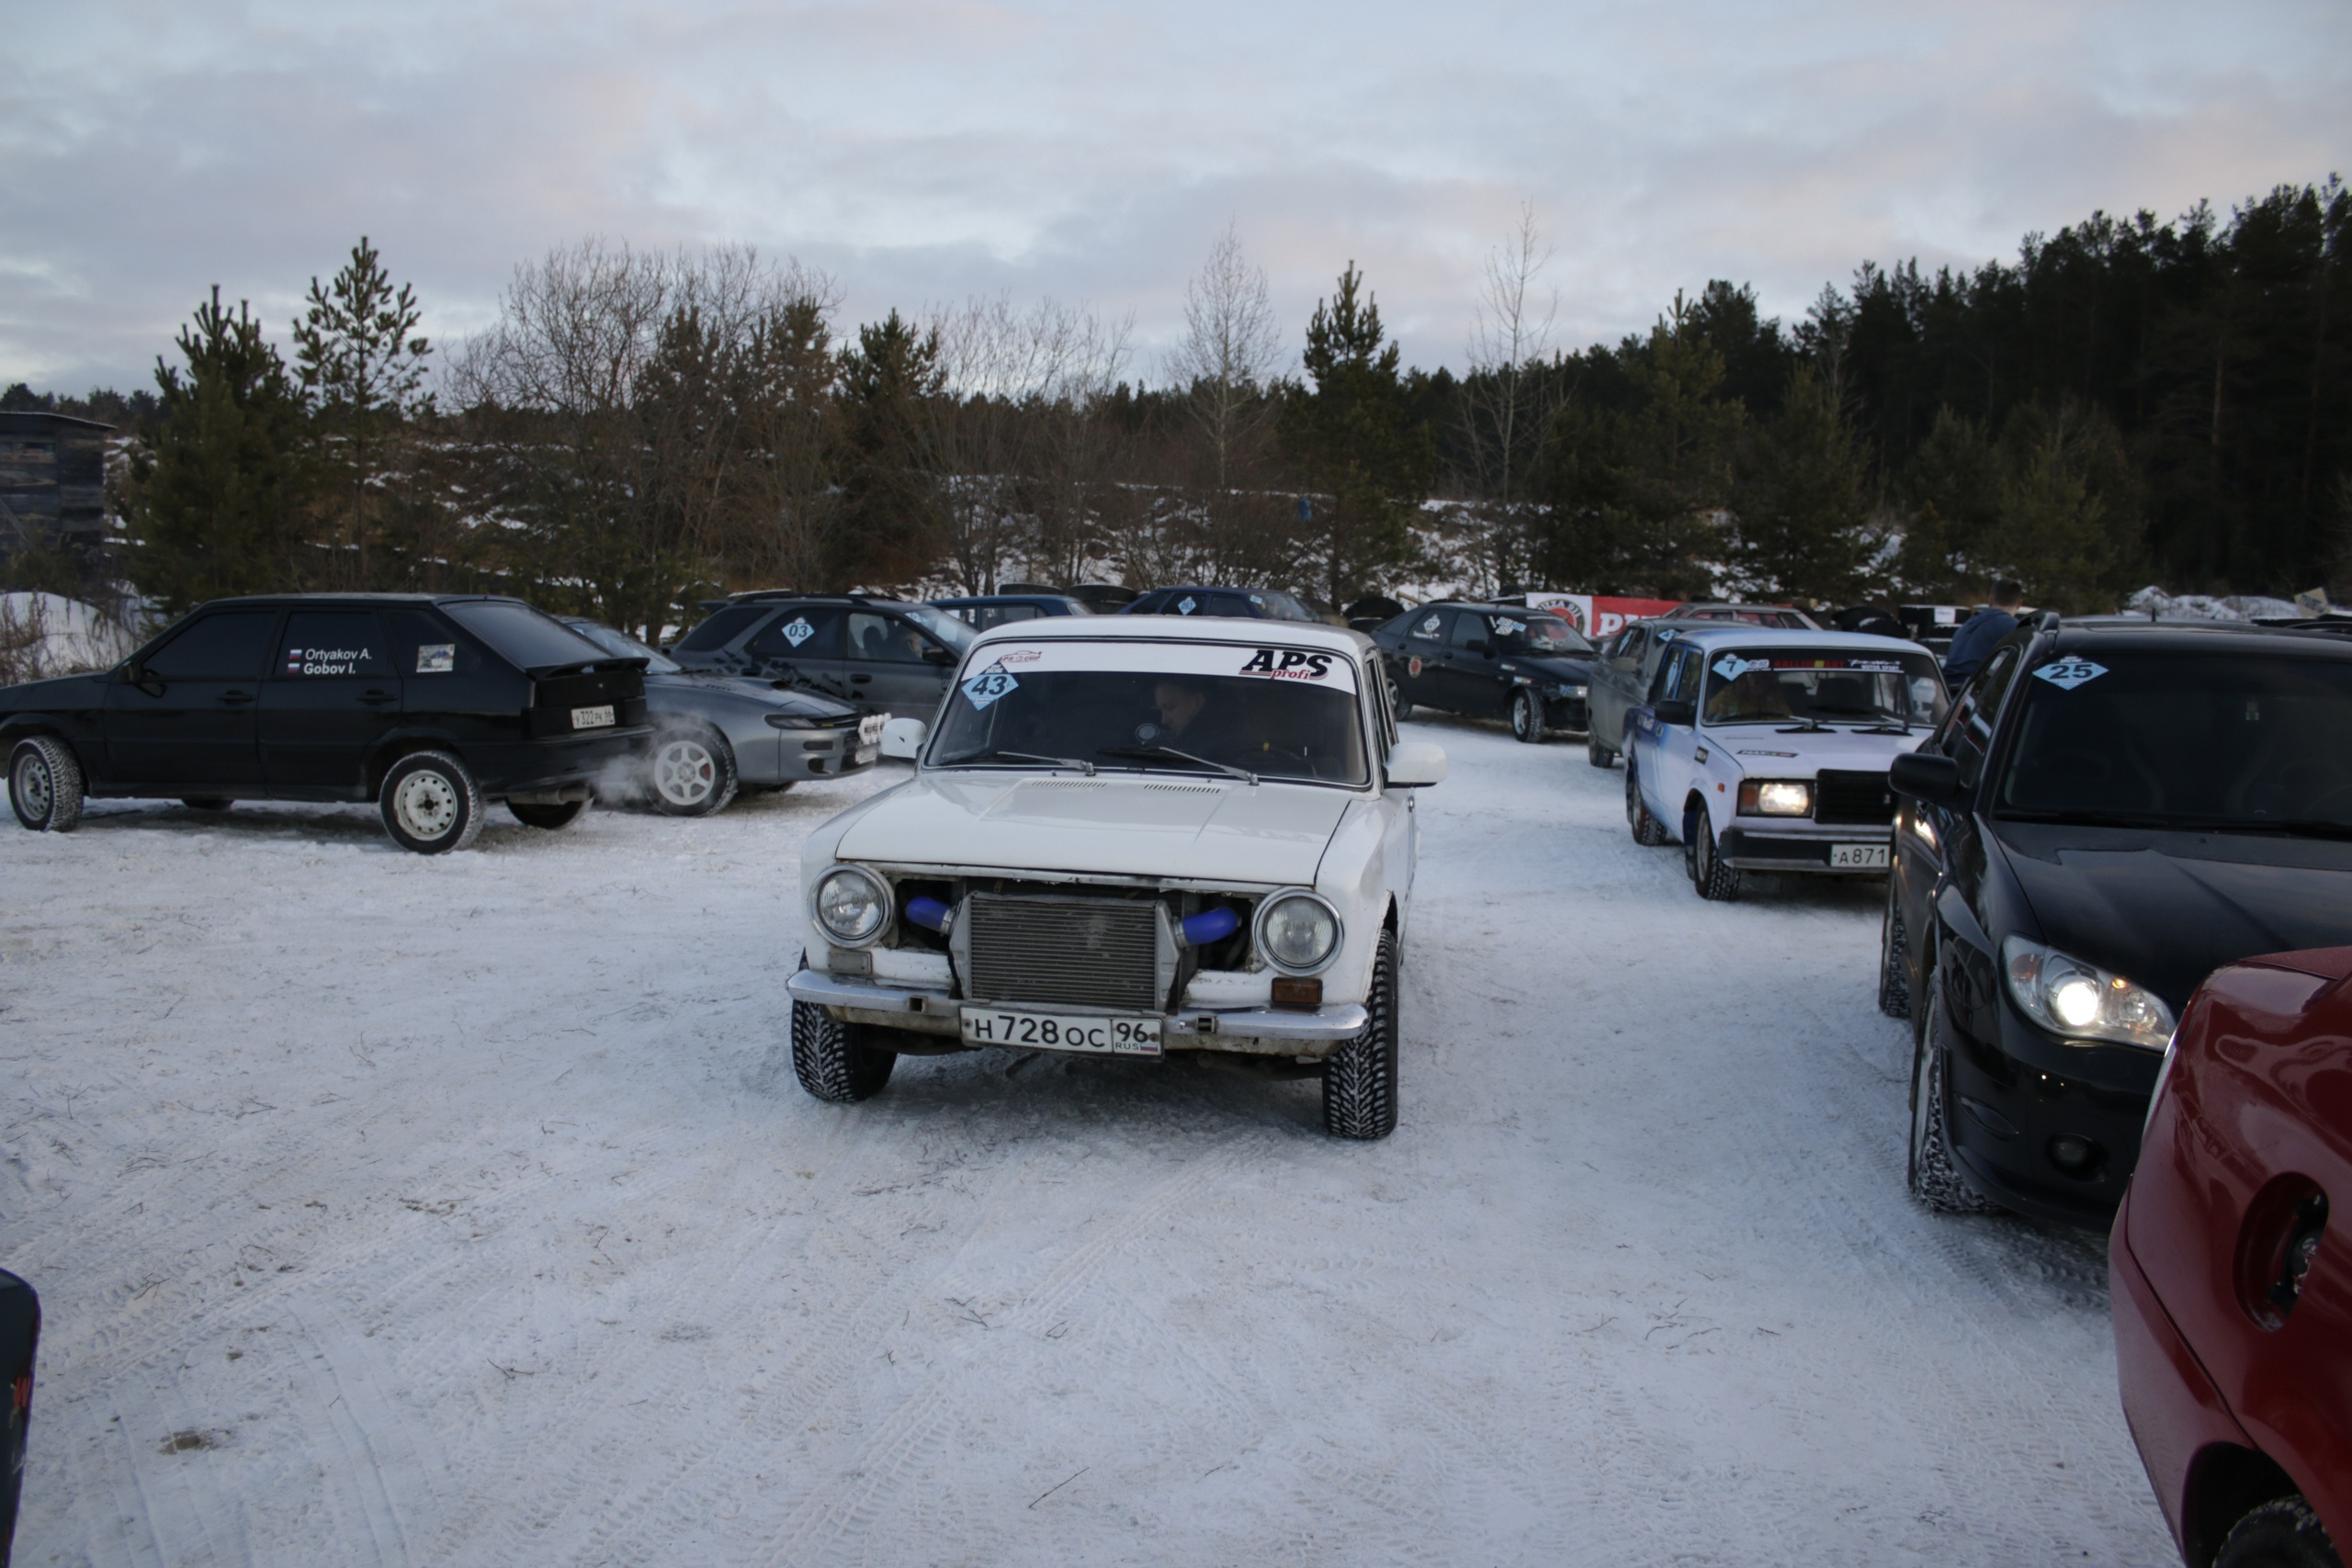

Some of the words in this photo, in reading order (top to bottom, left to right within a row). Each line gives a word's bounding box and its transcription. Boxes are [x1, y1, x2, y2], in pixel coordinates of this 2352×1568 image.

[1538, 601, 1566, 611] IZZA
[788, 625, 808, 637] 03
[305, 648, 357, 662] Ortyakov
[359, 648, 372, 660] A.
[303, 662, 345, 674] Gobov
[348, 661, 356, 674] I.
[1239, 649, 1333, 678] APS
[1725, 660, 1737, 672] 7
[1269, 669, 1311, 680] profi
[2049, 664, 2093, 680] 25
[971, 676, 1008, 695] 43
[1115, 1022, 1148, 1043] 96
[1114, 1042, 1139, 1051] RUS
